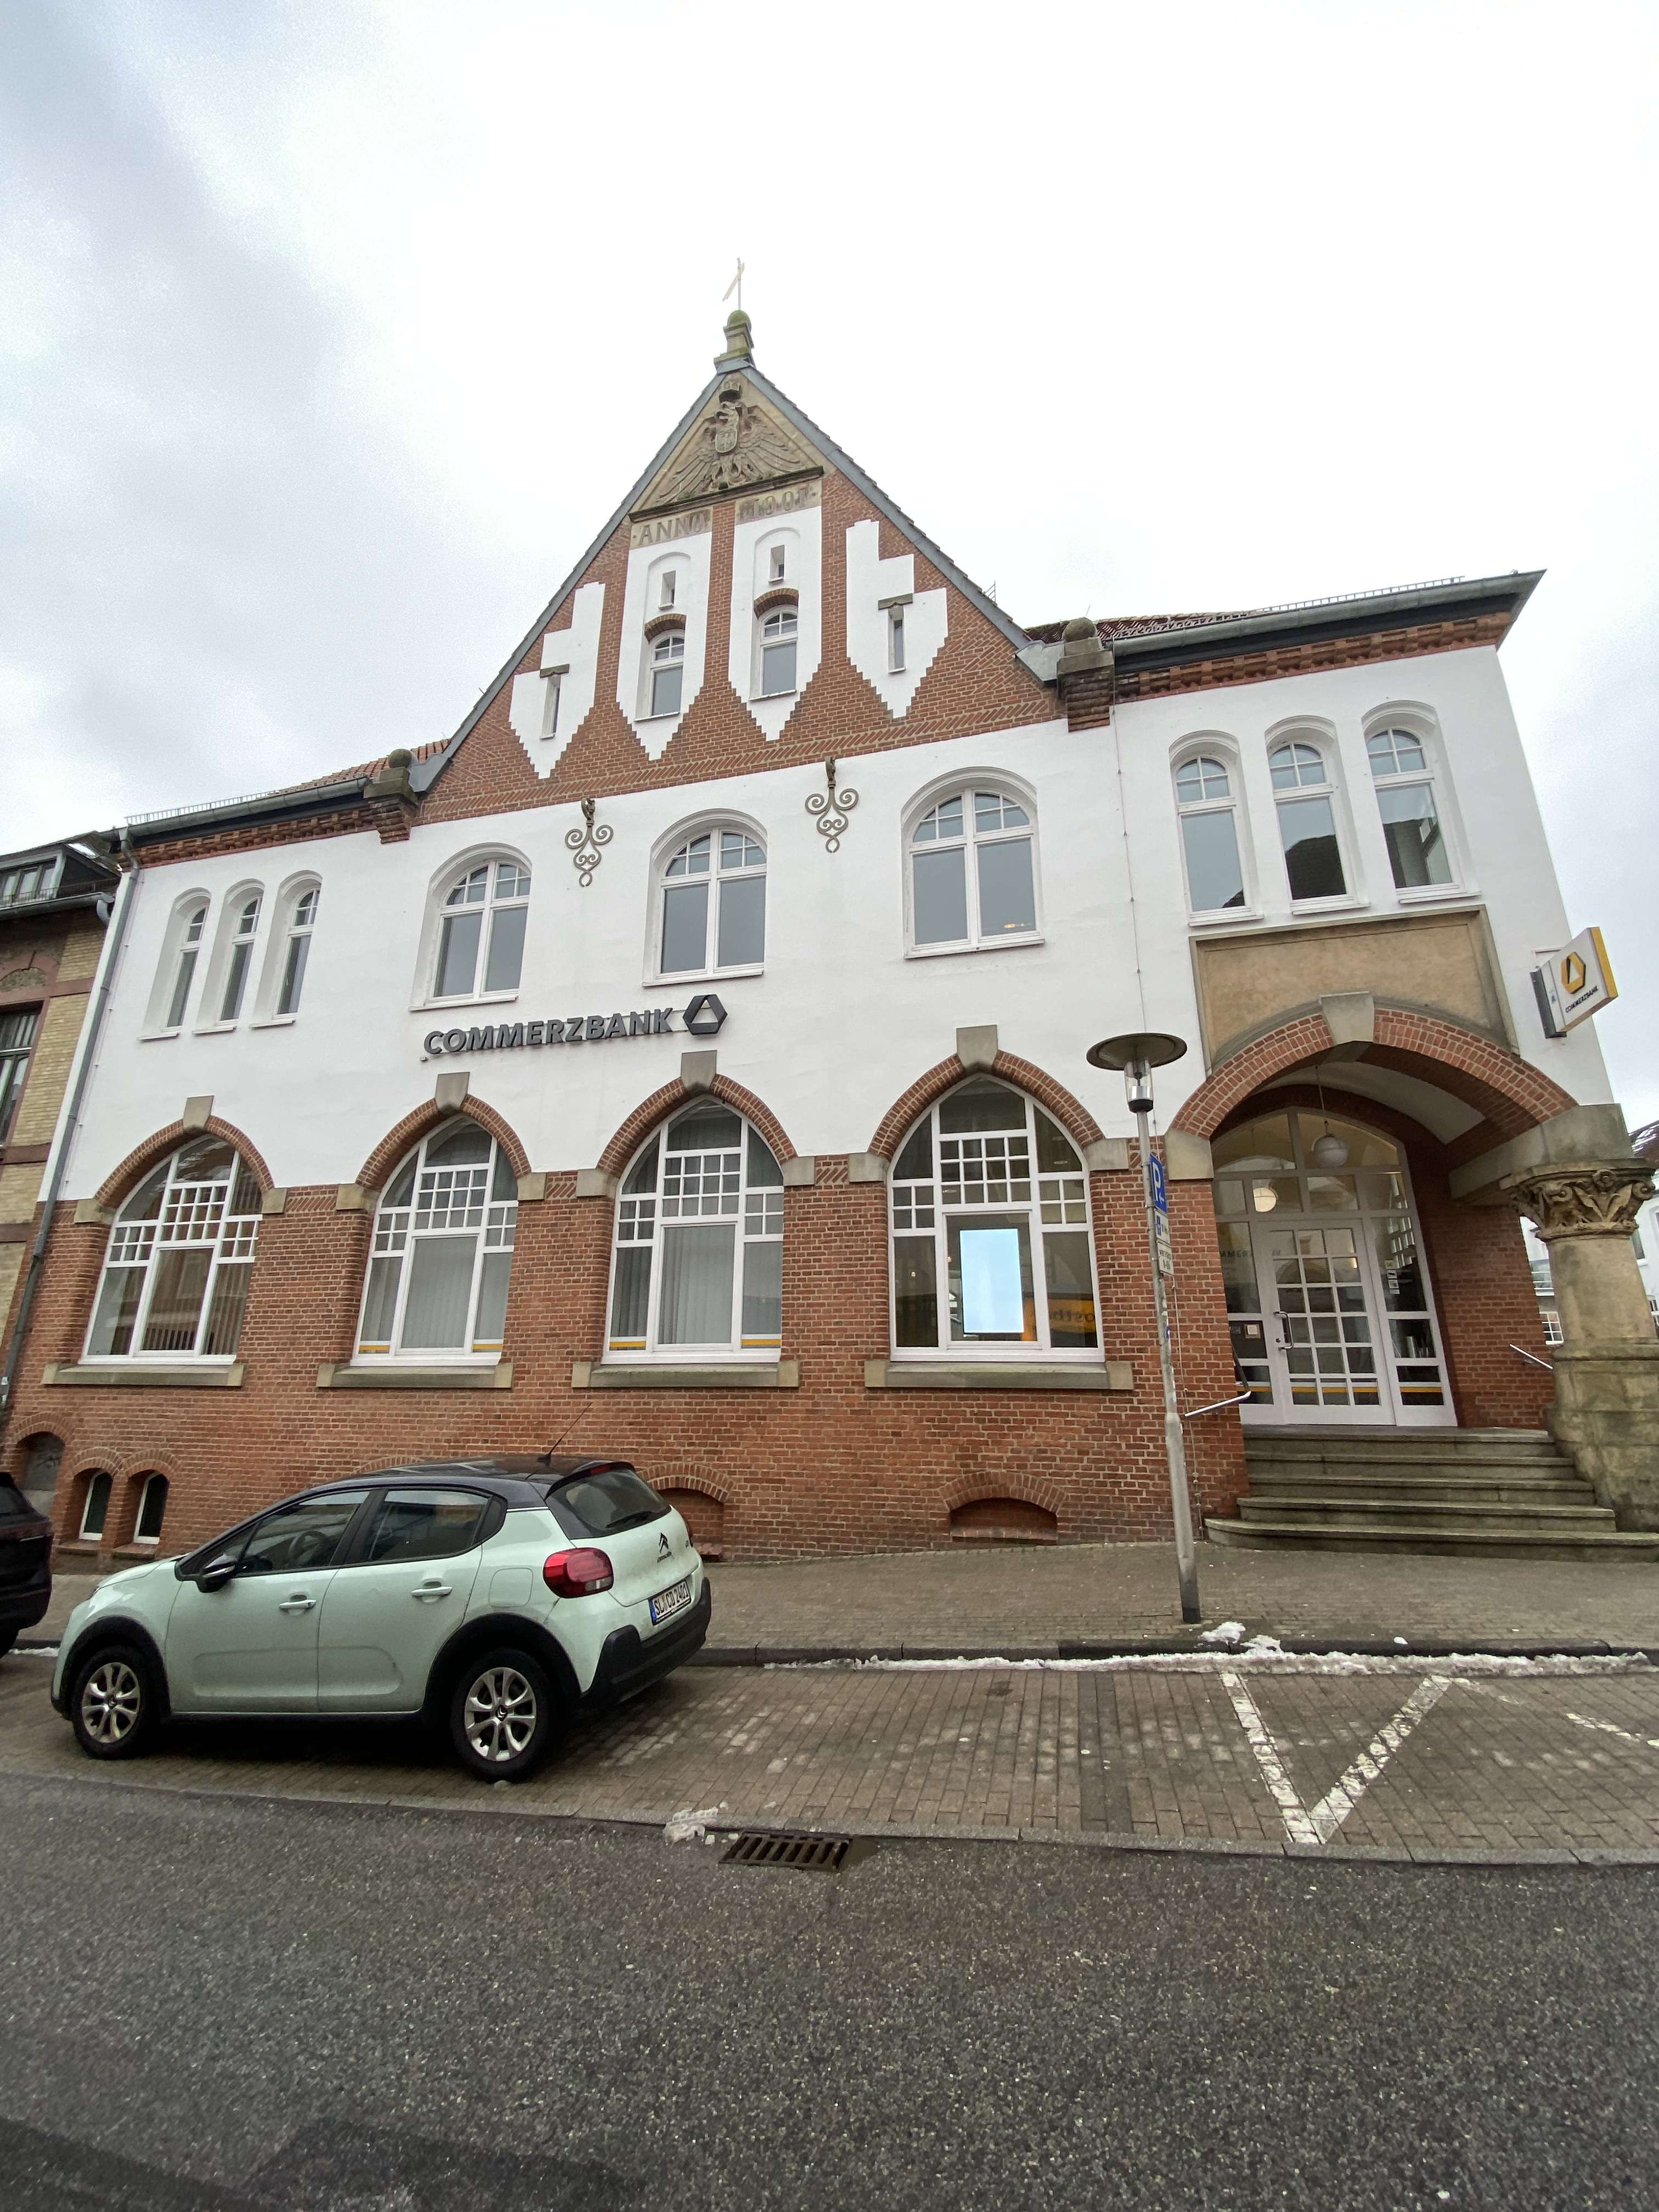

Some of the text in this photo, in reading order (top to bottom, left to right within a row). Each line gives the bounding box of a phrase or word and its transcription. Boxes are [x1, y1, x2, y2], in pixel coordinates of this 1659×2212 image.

[638, 510, 708, 545] ANNO
[1565, 985, 1598, 1013] COMMERZBANK
[424, 1008, 673, 1055] COMMERZBANK
[1153, 1162, 1161, 1201] P
